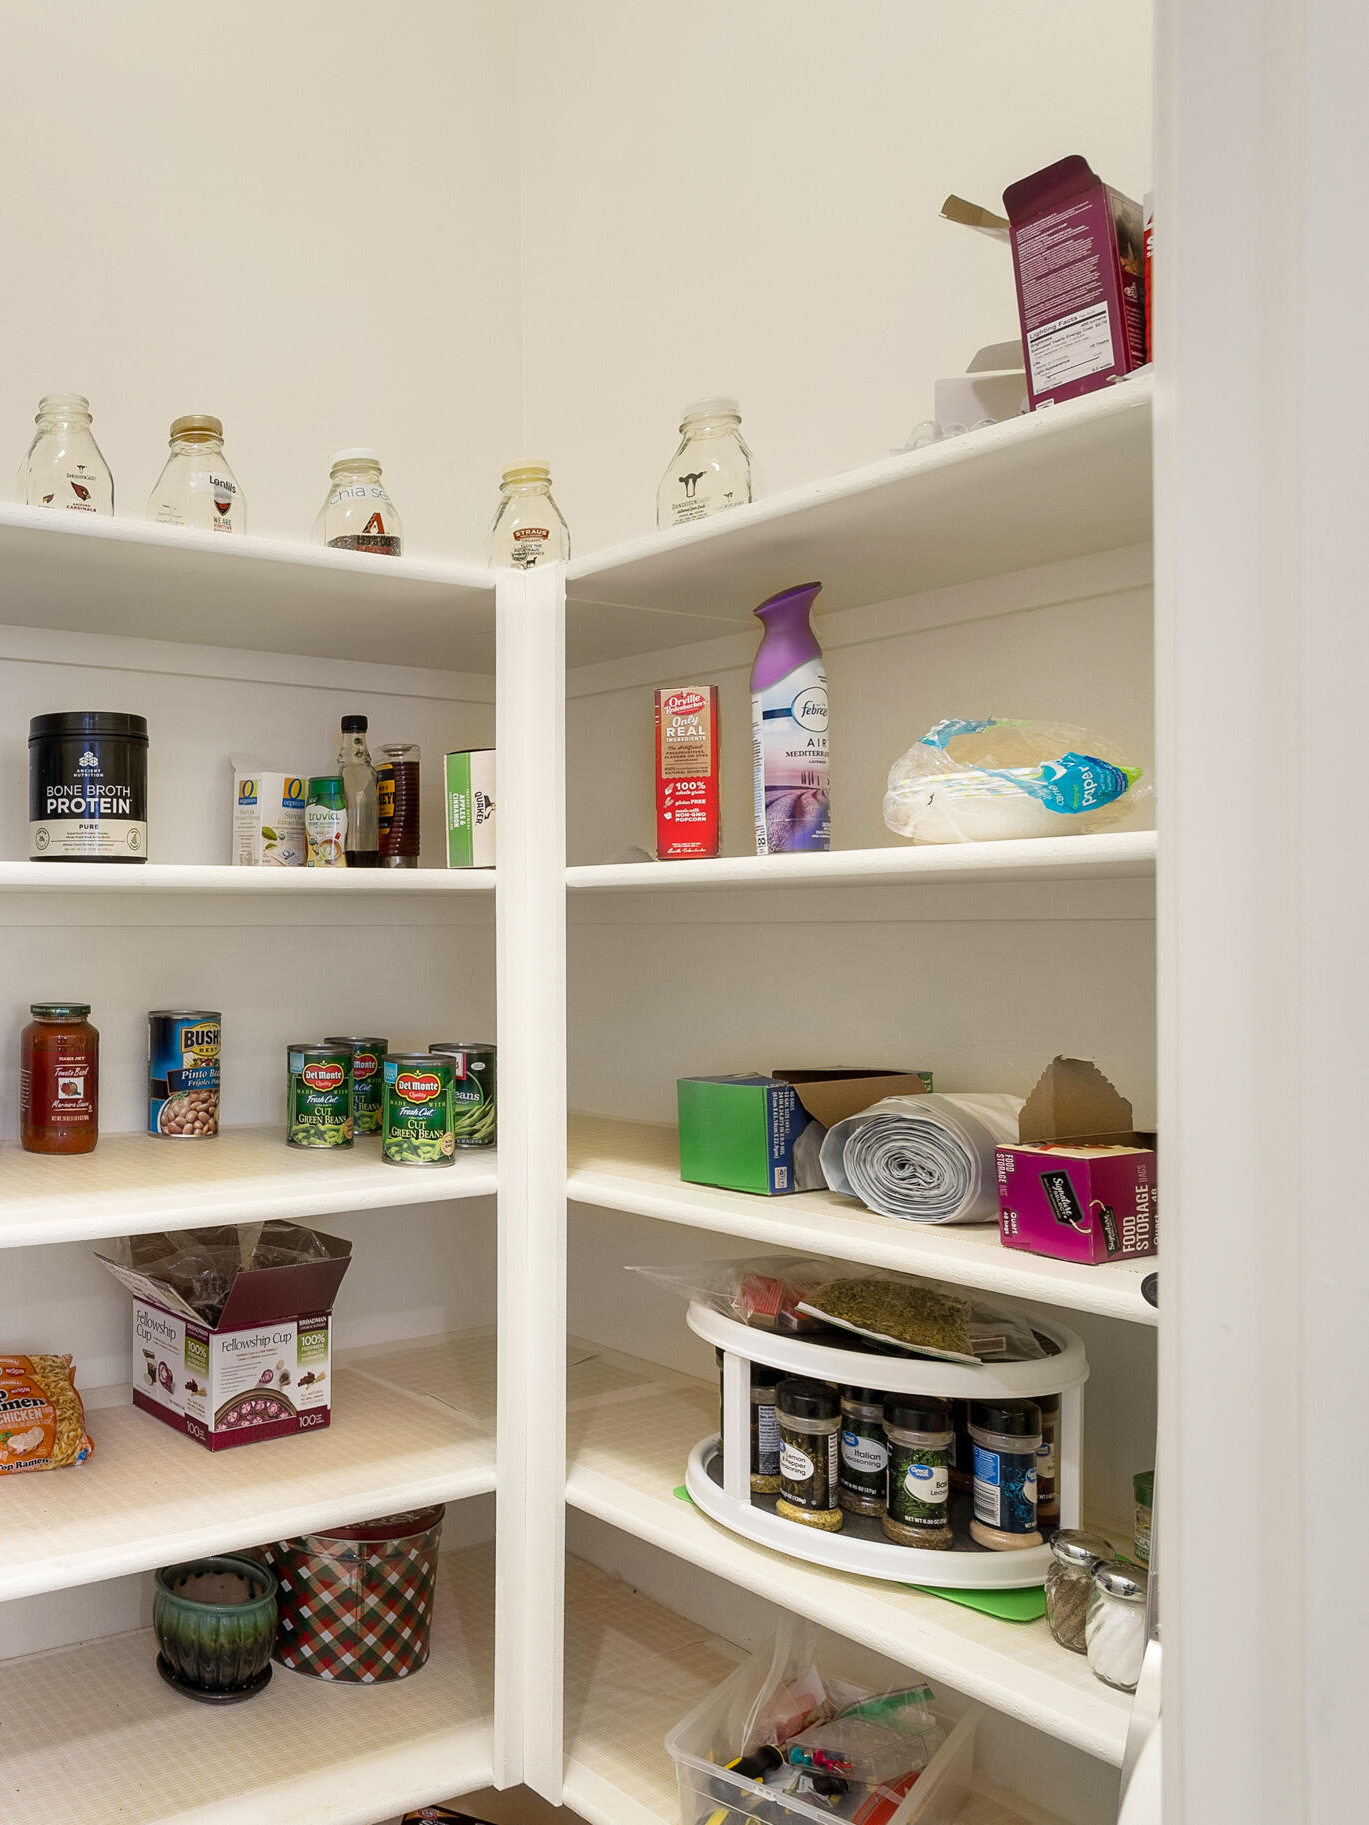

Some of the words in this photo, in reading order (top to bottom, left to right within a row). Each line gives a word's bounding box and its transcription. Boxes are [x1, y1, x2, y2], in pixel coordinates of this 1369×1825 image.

[1029, 325, 1057, 339] Lighting
[1058, 316, 1078, 327] Facts
[209, 475, 236, 494] Lentils
[515, 529, 547, 537] STRAUS
[668, 694, 701, 708] Orville
[672, 714, 700, 728] Only
[666, 725, 706, 737] REAL
[666, 735, 706, 743] INGREDIENTS
[46, 785, 82, 797] BONE
[86, 785, 131, 797] BROTH
[675, 781, 706, 790] 100%
[1078, 766, 1098, 807] paper
[46, 797, 130, 814] PROTEIN
[452, 792, 460, 828] CINNAMON
[474, 791, 485, 825] QUAKER
[308, 810, 340, 821] truvia
[184, 1029, 220, 1049] BUSH
[181, 1070, 208, 1080] Pinto
[305, 1070, 318, 1079] Del
[318, 1070, 342, 1079] Monte
[398, 1081, 411, 1090] Del
[411, 1081, 438, 1091] Monte
[306, 1095, 325, 1104] Fresh
[314, 1106, 332, 1116] CUT
[399, 1106, 419, 1116] Fresh
[418, 1107, 434, 1116] Cut
[298, 1113, 324, 1124] GREEN
[324, 1115, 347, 1124] BEANS
[407, 1120, 427, 1129] CUT
[391, 1126, 418, 1138] GREEN
[418, 1128, 444, 1139] BEANS
[996, 1153, 1007, 1183] STORAGE
[1004, 1154, 1015, 1172] FOOD
[1051, 1177, 1073, 1217] Signature
[1010, 1212, 1018, 1234] Quart
[1135, 1184, 1149, 1251] STORAGE
[1122, 1215, 1136, 1253] FOOD
[136, 1309, 177, 1342] Fellowship
[136, 1324, 152, 1343] Cup
[301, 1333, 326, 1346] 100%
[187, 1340, 207, 1358] 100%
[221, 1334, 271, 1352] Fellowship
[272, 1332, 292, 1344] Cup
[299, 1414, 316, 1427] 100
[187, 1421, 199, 1437] 100
[854, 1449, 881, 1460] Italian
[15, 1458, 49, 1470] Ramen
